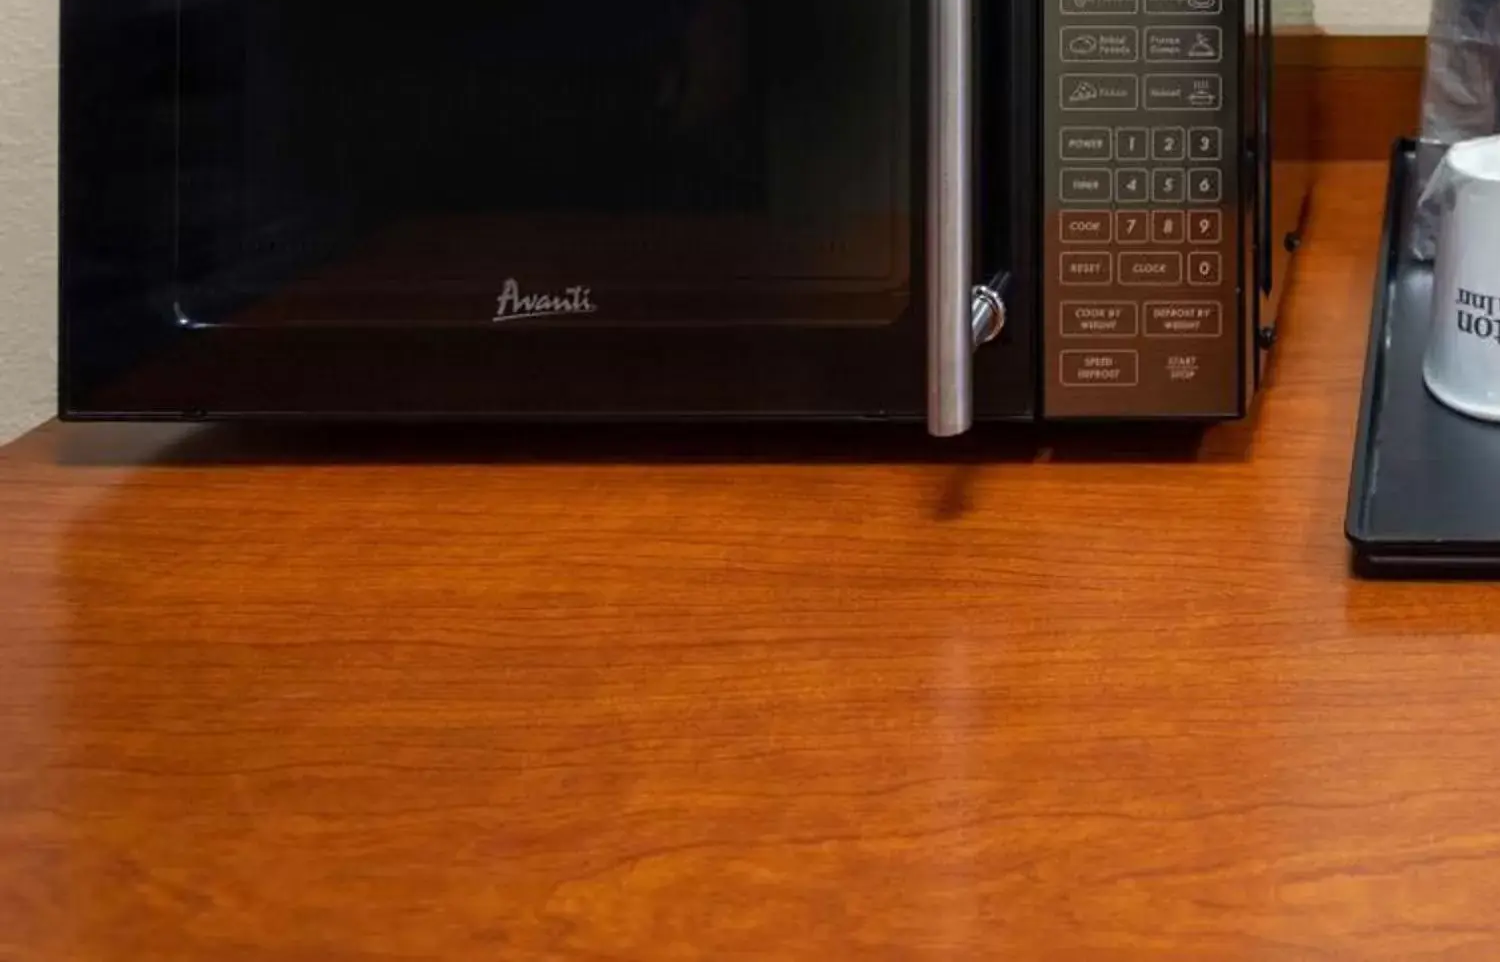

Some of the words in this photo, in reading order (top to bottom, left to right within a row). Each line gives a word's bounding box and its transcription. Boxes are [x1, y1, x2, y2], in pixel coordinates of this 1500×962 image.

[1068, 139, 1104, 149] POWER
[1128, 138, 1136, 152] 1
[1163, 138, 1175, 152] 2
[1199, 138, 1210, 152] 3
[1126, 178, 1137, 192] 4
[1163, 178, 1174, 192] 5
[1199, 178, 1210, 192] 6
[1069, 221, 1100, 231] COOK
[1126, 219, 1137, 234] 7
[1163, 219, 1174, 234] 8
[1199, 219, 1210, 234] 9
[1070, 263, 1101, 273] RESET
[1132, 263, 1167, 273] CLOCK
[1199, 261, 1210, 275] 0
[496, 277, 592, 316] Avanti
[1455, 287, 1494, 316] Inn
[1075, 308, 1106, 318] COOK
[1084, 356, 1113, 367] SPEED
[1167, 356, 1198, 366] START
[1169, 369, 1197, 380] STOP
